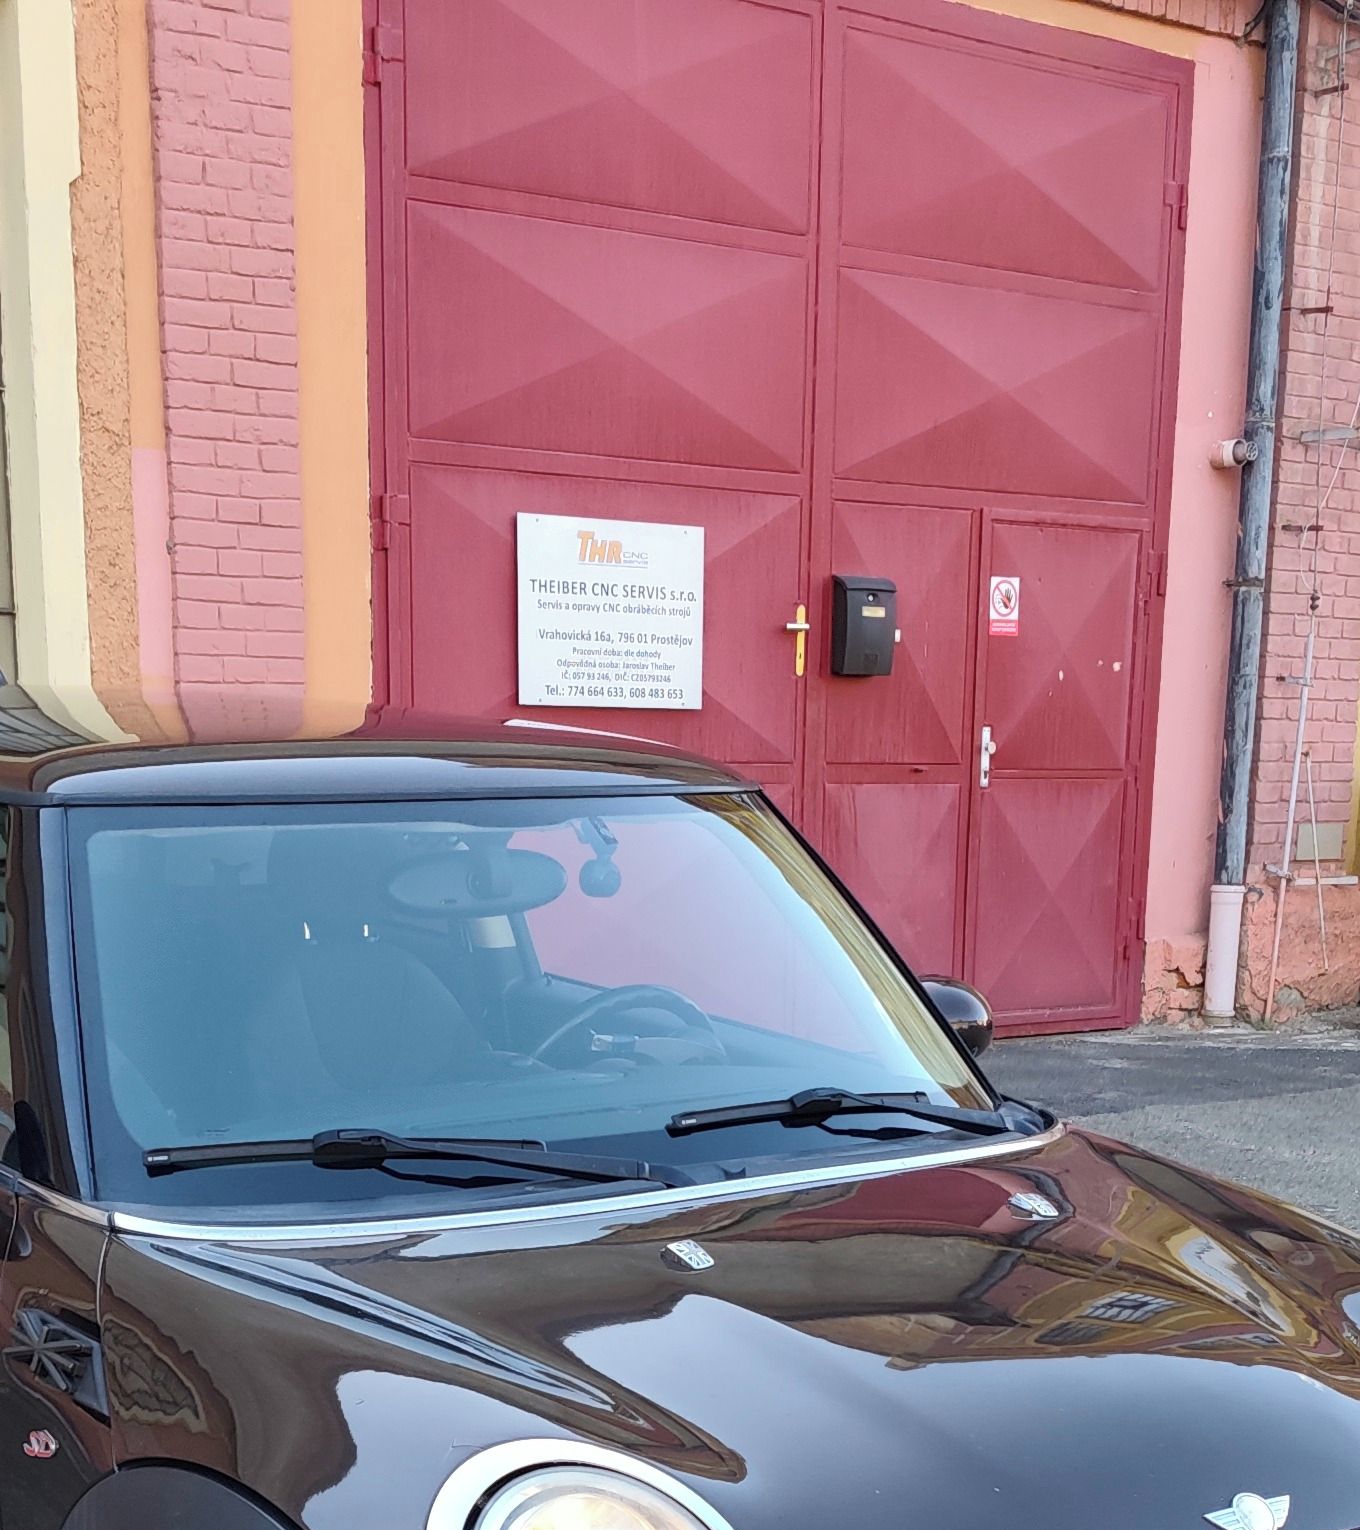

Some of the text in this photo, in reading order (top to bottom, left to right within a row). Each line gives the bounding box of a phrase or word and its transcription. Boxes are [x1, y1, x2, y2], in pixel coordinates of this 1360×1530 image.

[577, 530, 622, 564] THR
[623, 551, 648, 560] CNC
[529, 579, 697, 602] THEIBER CNC SERVIS s.r.o.
[537, 599, 562, 610] Servis
[572, 603, 600, 613] opravy
[603, 602, 620, 613] CNC
[668, 606, 691, 619] strojů
[539, 628, 693, 648] Vrahovická 16a, 796 01 Prostějov
[636, 649, 661, 660] dohody
[545, 684, 683, 700] Tel.: 774 664 633, 608 483 653
